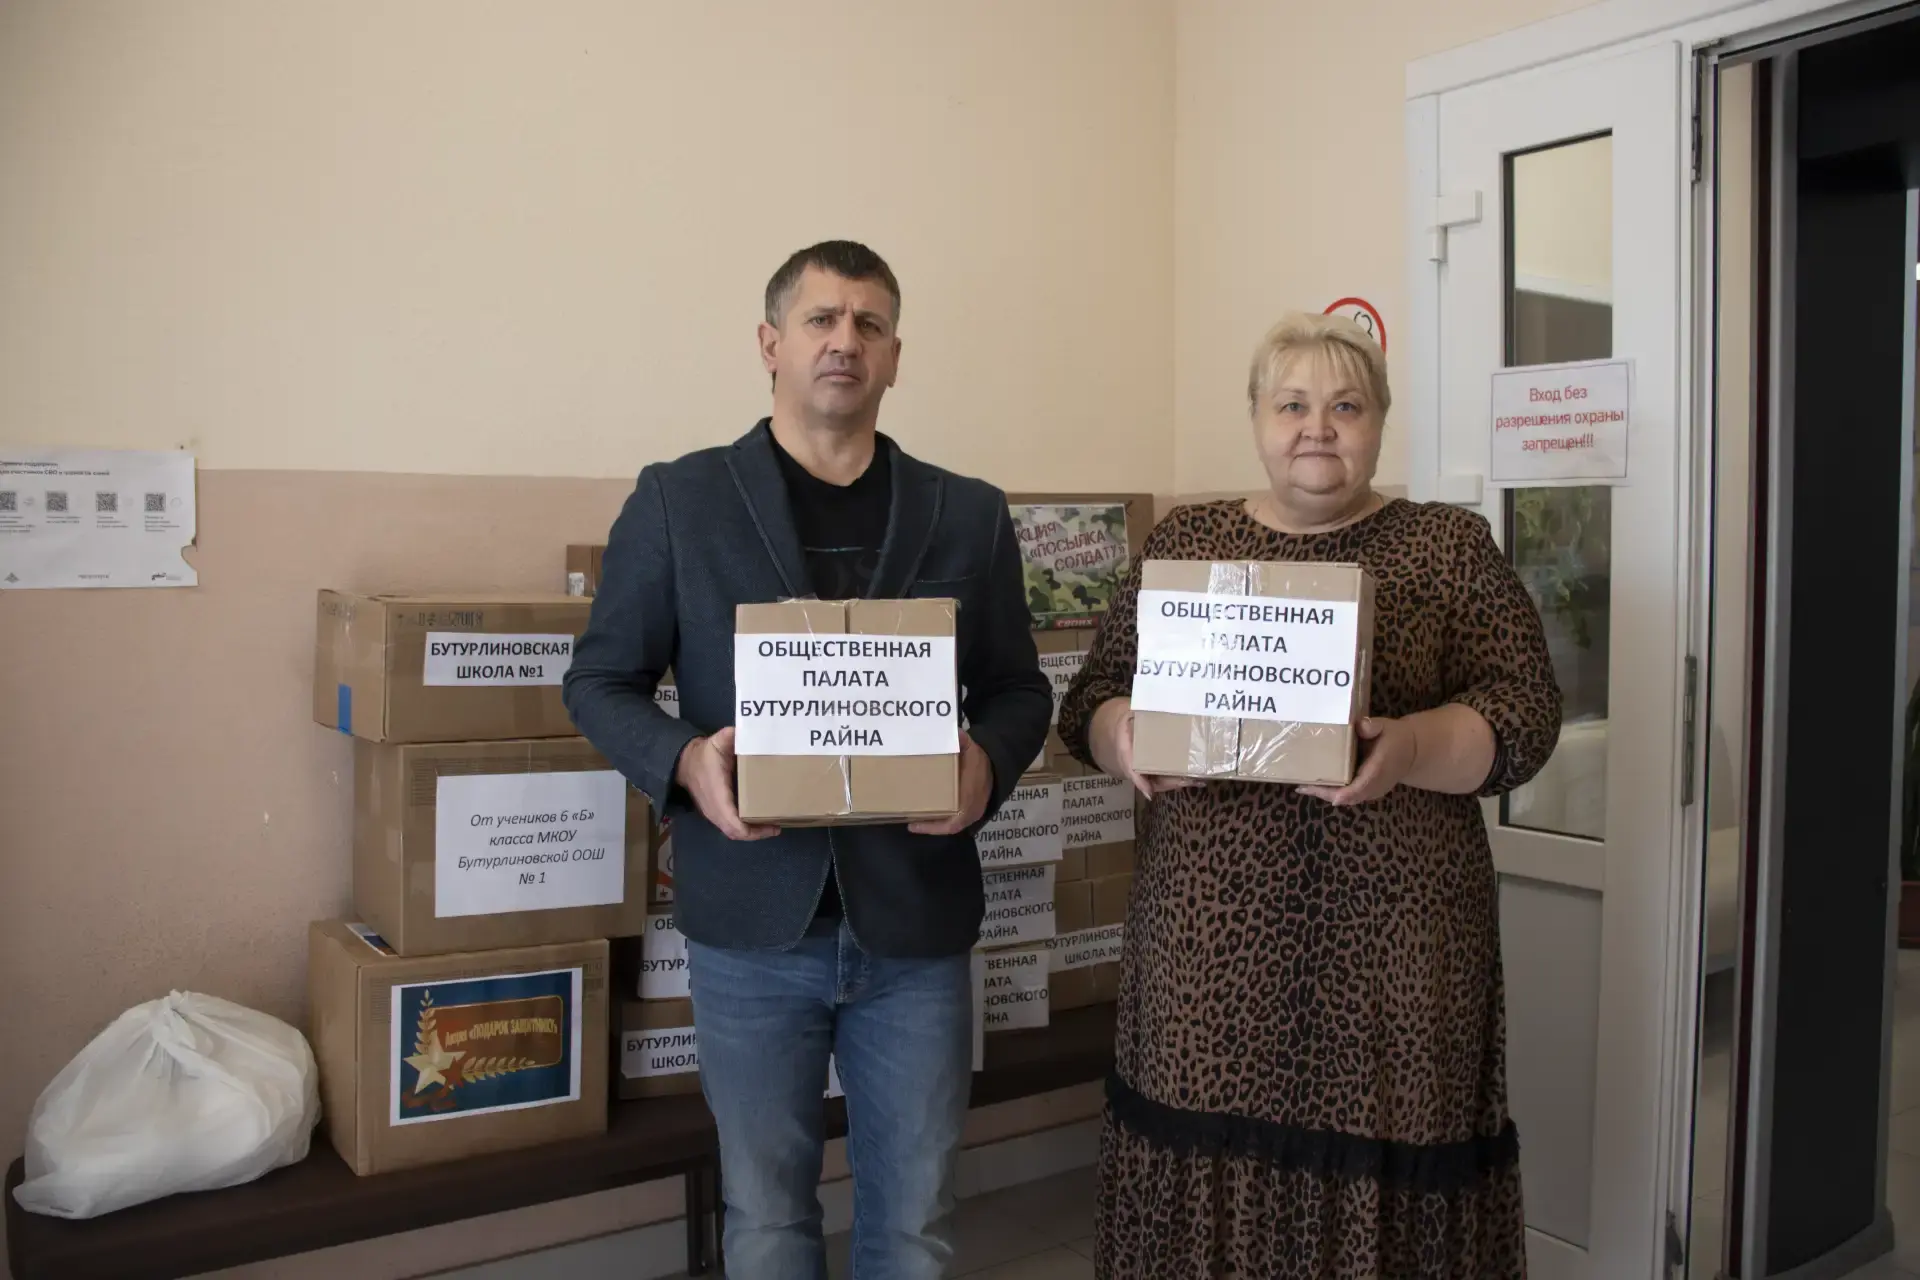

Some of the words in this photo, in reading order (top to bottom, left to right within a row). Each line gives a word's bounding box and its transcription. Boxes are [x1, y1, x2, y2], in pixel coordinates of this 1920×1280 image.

[1529, 387, 1562, 404] Вход
[1565, 385, 1588, 400] без
[1496, 413, 1571, 431] разрешения
[1574, 410, 1624, 427] охраны
[1522, 433, 1594, 453] запрещен!!!
[1017, 521, 1056, 543] КЦИЯ
[1030, 530, 1106, 558] «ПОСЫЛКА
[1054, 544, 1125, 572] СОЛДАТУ»
[1161, 600, 1334, 625] ОБЩЕСТВЕННАЯ
[431, 642, 570, 656] БУТУРЛИНОВСКАЯ
[758, 640, 931, 660] ОБЩЕСТВЕННАЯ
[1040, 655, 1089, 669] БЩЕСТВ
[457, 665, 514, 679] ШКОЛА
[519, 665, 545, 678] №1
[803, 670, 889, 687] ПАЛАТА
[1140, 659, 1350, 687] БУТУРЛИНОВСКОГО
[741, 700, 952, 717] БУТУРЛИНОВСКОГО
[1204, 690, 1277, 714] РАЙНА
[810, 725, 884, 747] РАЙНА
[1063, 796, 1104, 810] ПАЛАТА
[470, 814, 494, 827] От
[497, 812, 557, 828] учеников
[560, 810, 569, 822] 6
[572, 809, 595, 821] «Б»
[992, 809, 1025, 822] ЛАТА
[489, 833, 534, 846] класса
[537, 829, 578, 844] МКОУ
[1067, 829, 1102, 845] РАЙНА
[458, 850, 569, 872] Бутурлиновской
[572, 848, 605, 862] ООШ
[982, 845, 1023, 860] РАЙНА
[518, 873, 535, 885] №
[538, 872, 546, 884] 1
[984, 901, 1054, 922] ИНОВСКОГО
